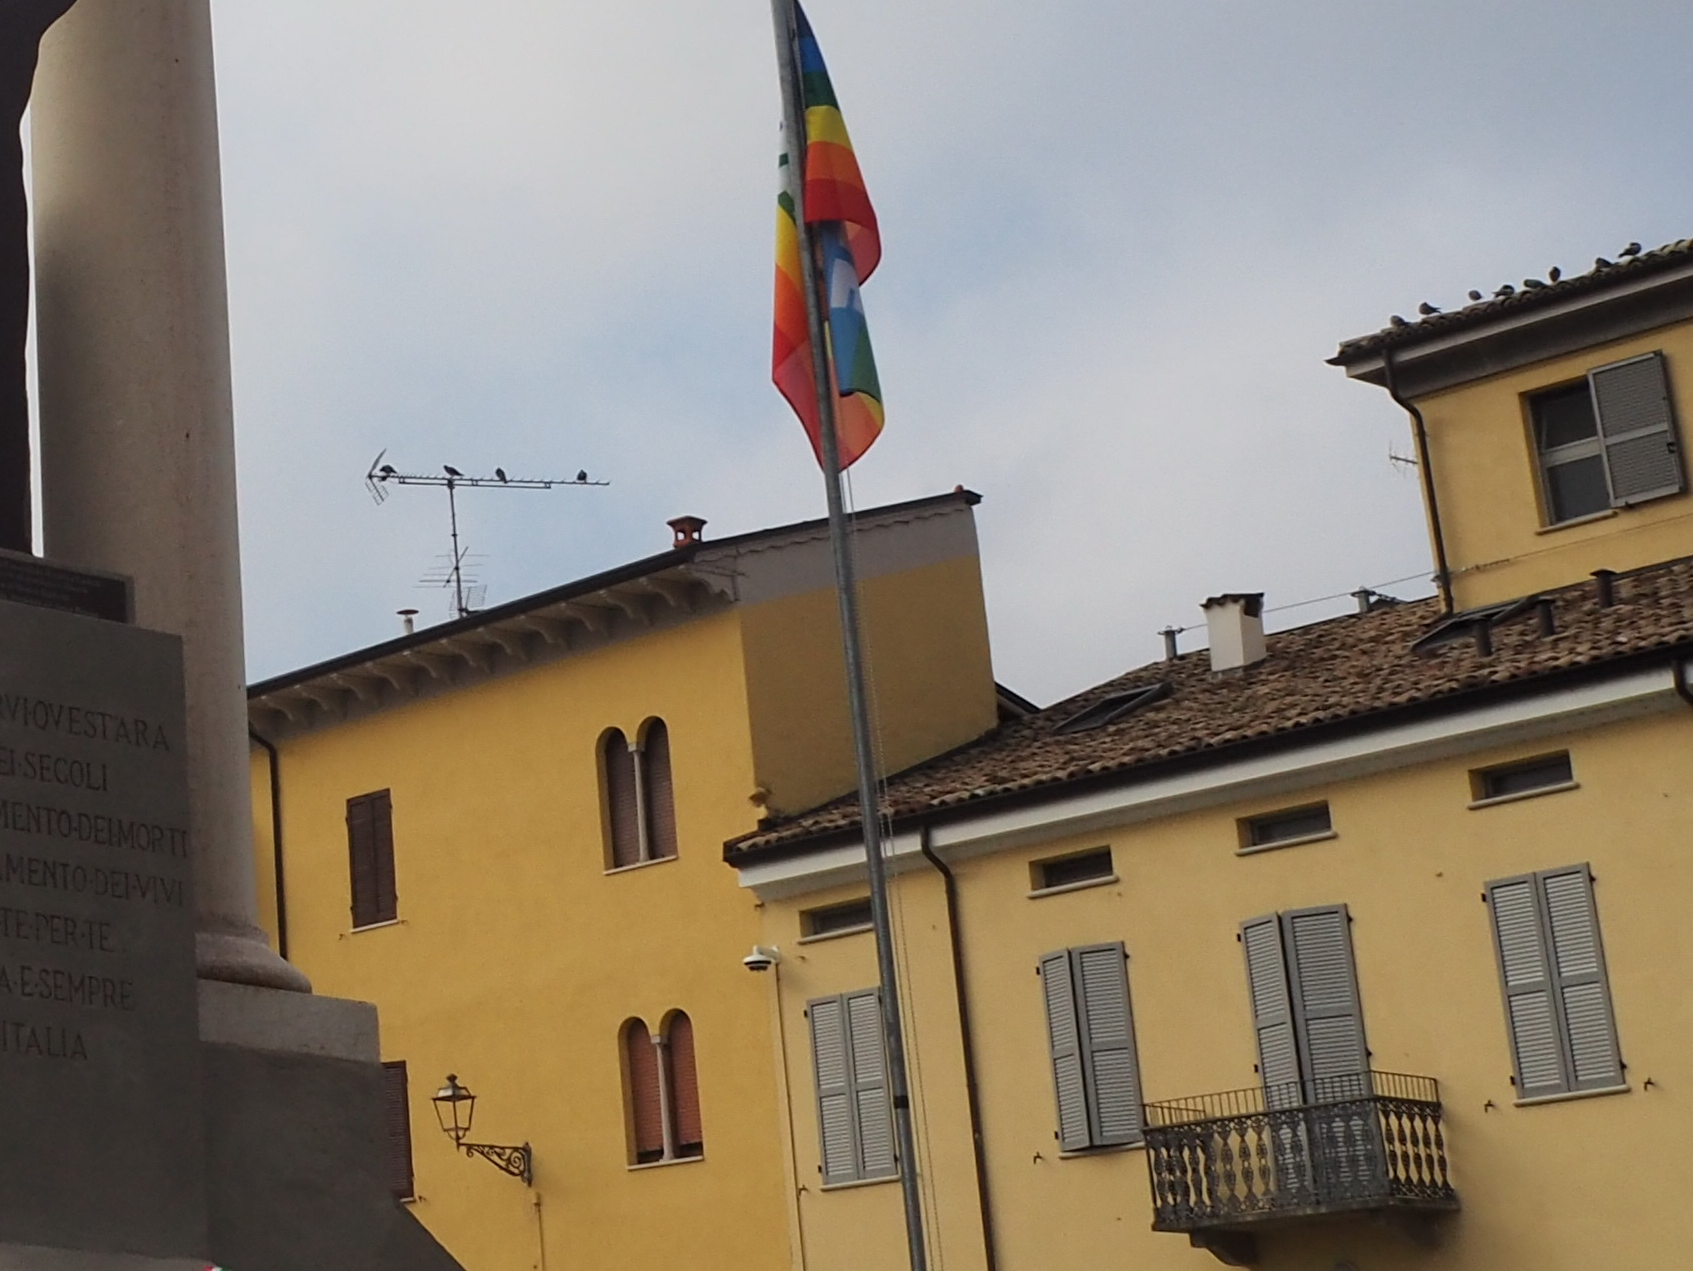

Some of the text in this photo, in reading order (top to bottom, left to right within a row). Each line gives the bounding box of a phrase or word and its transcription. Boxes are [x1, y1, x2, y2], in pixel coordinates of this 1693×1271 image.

[22, 751, 109, 792] SECOLI
[77, 813, 113, 848] DEI
[115, 820, 189, 859] MORTI
[94, 868, 131, 901] DEI
[134, 873, 184, 908] VIVI
[0, 907, 29, 940] TE
[34, 912, 78, 945] PER
[83, 920, 115, 954] TE
[38, 968, 137, 1012] SEMPRE
[2, 1019, 89, 1061] ITALIA
